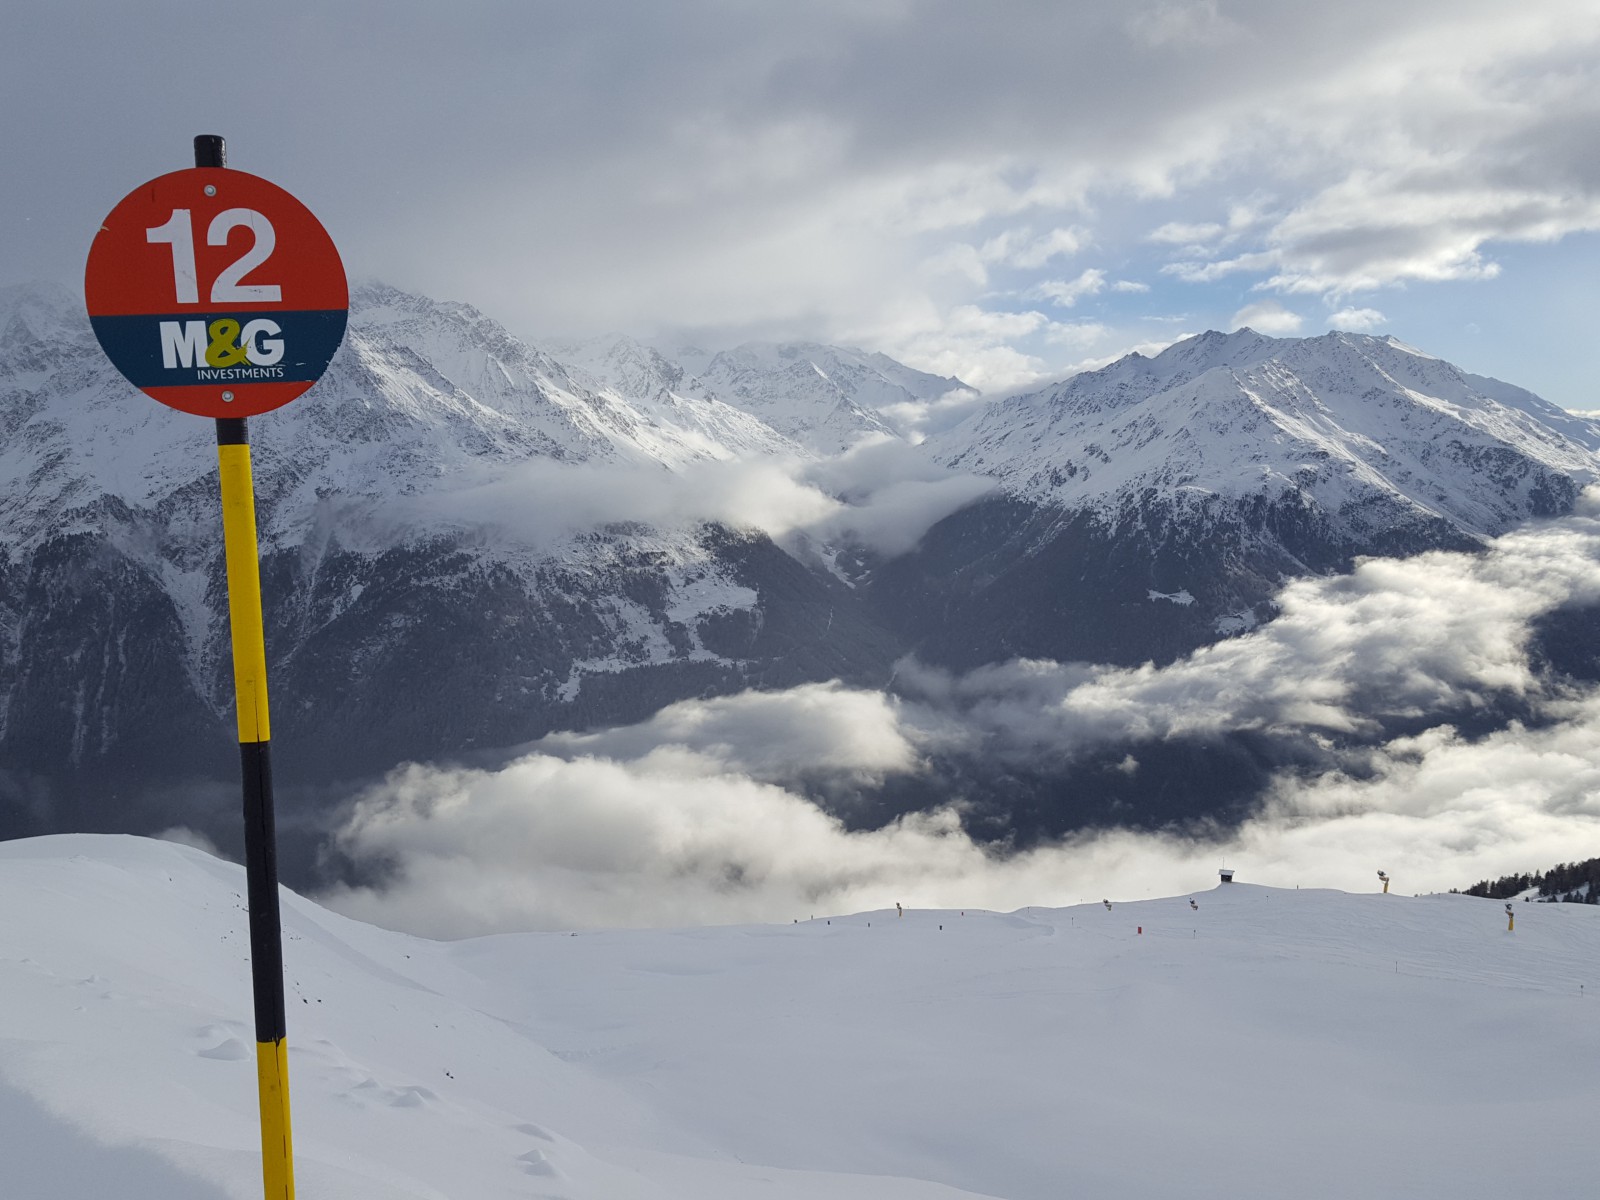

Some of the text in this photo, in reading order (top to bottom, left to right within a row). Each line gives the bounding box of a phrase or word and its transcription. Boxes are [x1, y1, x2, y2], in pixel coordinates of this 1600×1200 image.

[146, 207, 282, 304] 12
[159, 318, 285, 369] M&G
[197, 367, 284, 380] INVESTMENTS
